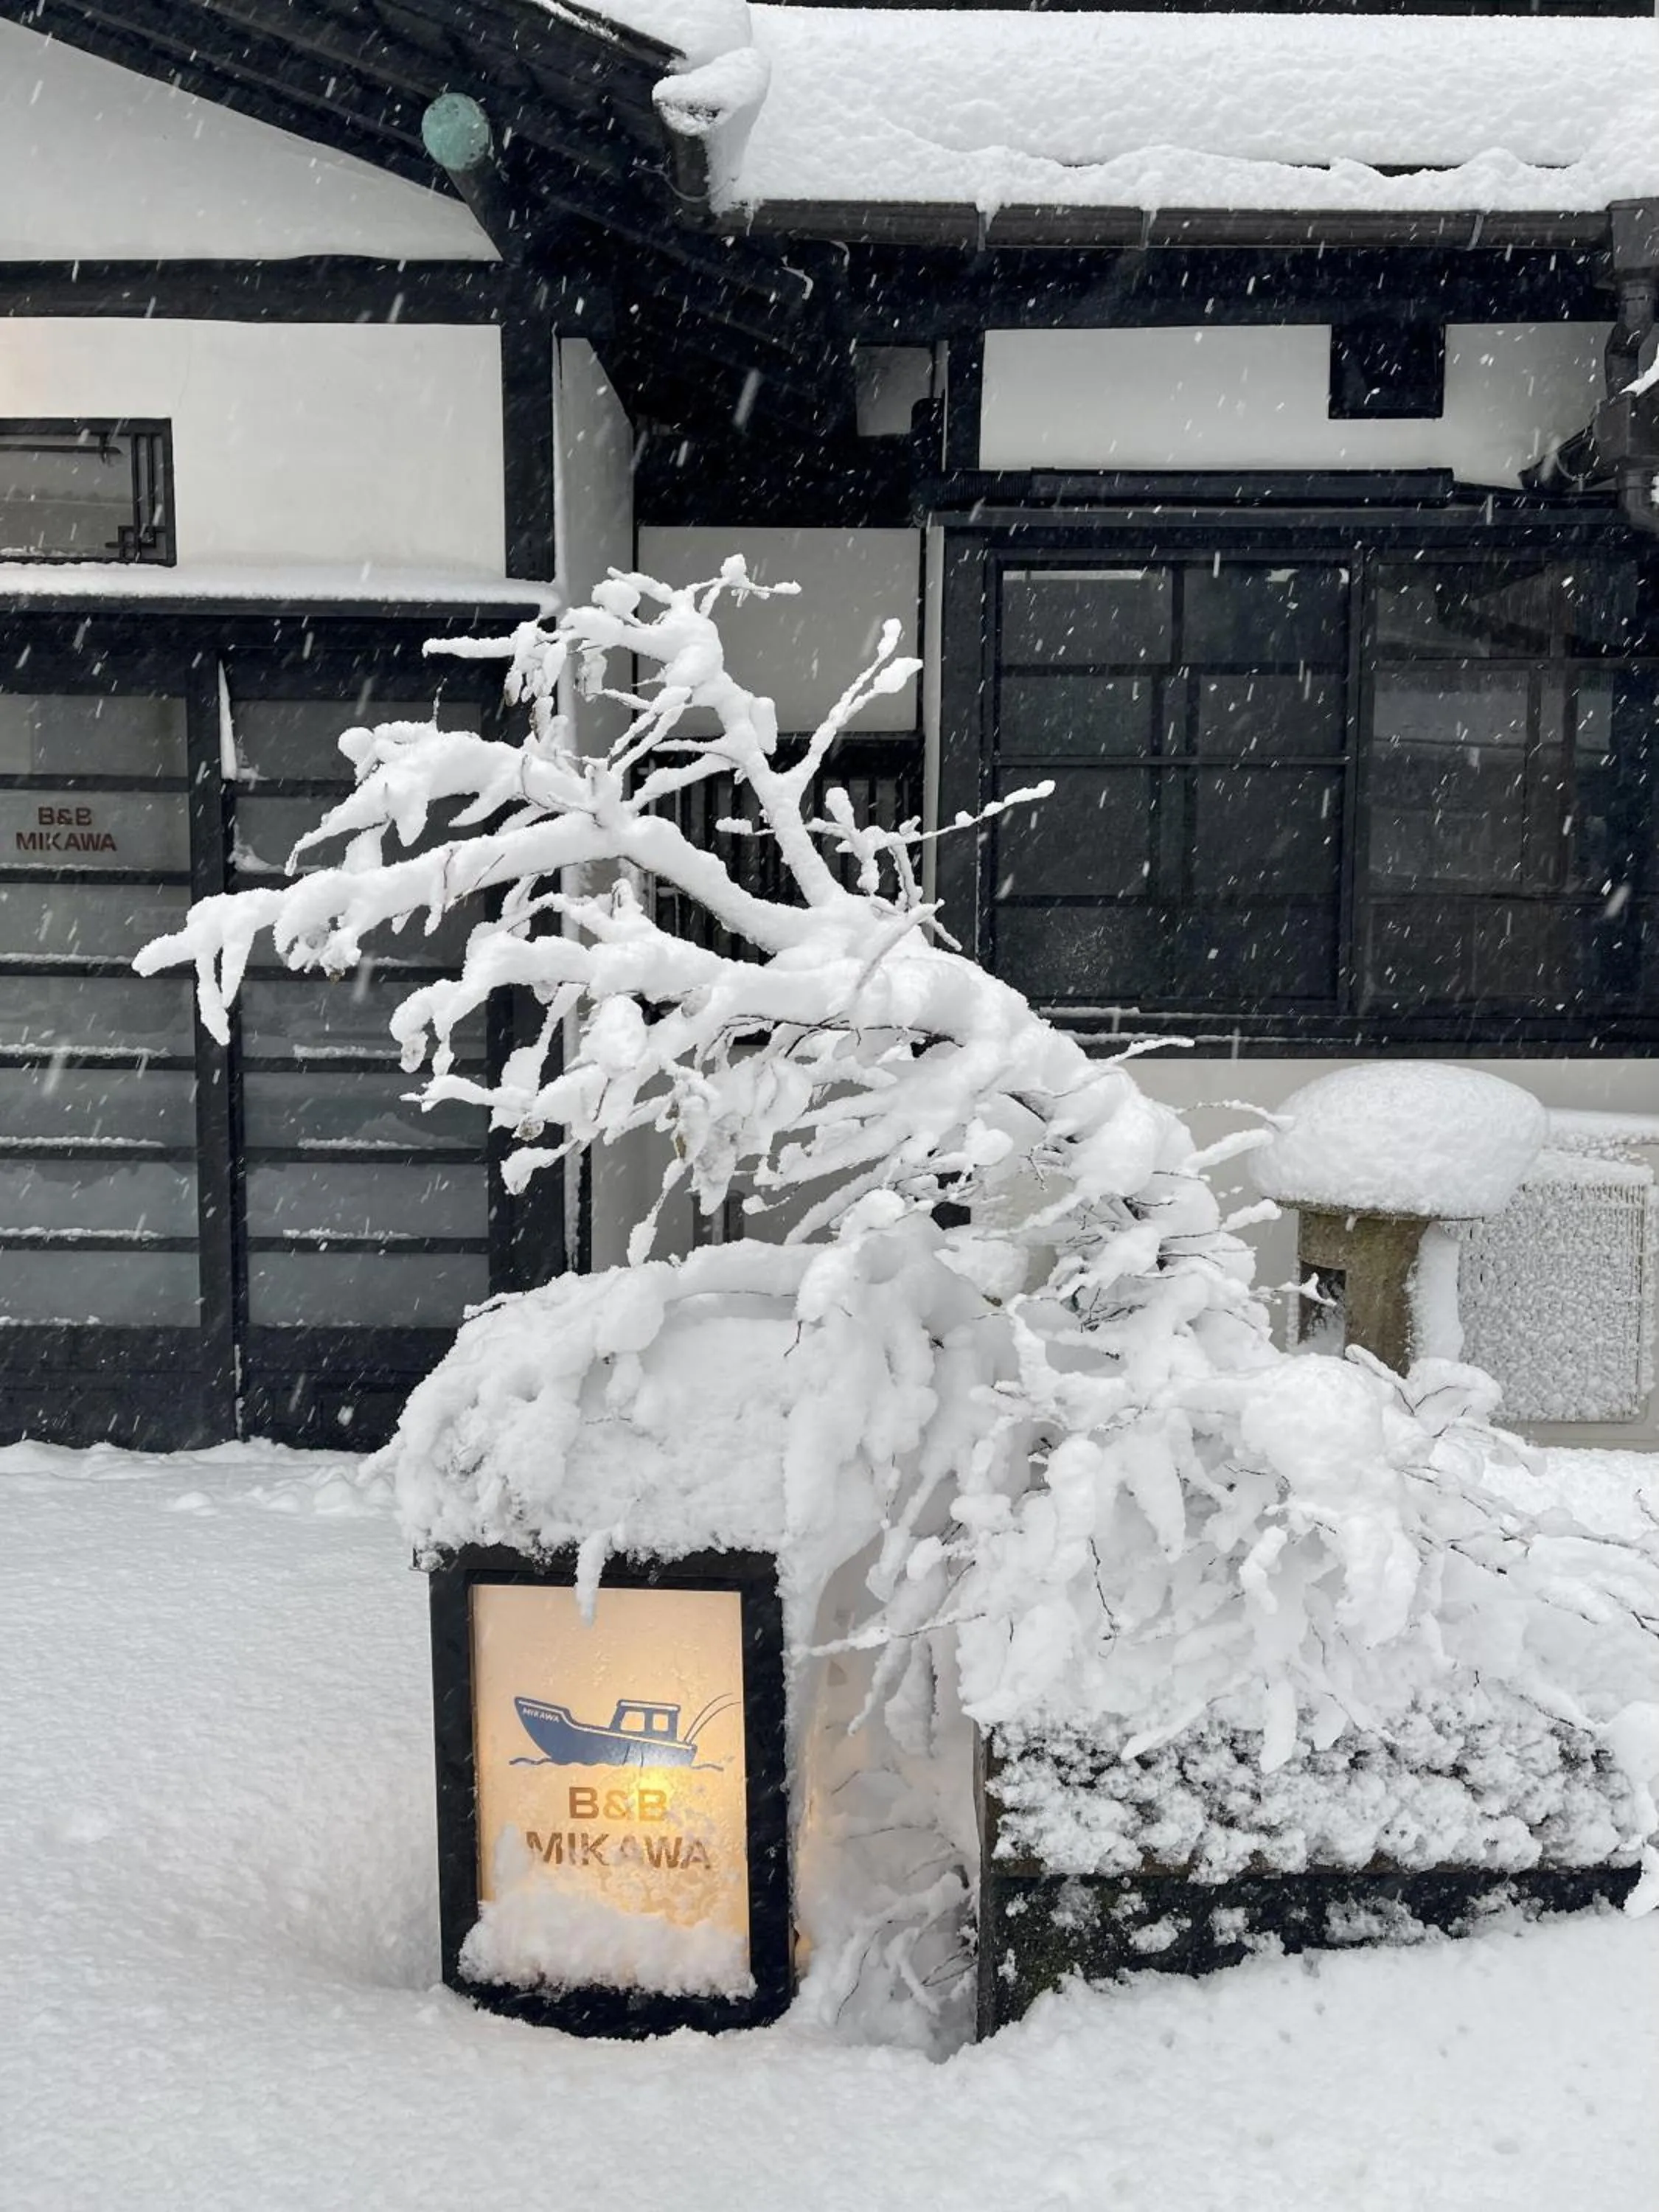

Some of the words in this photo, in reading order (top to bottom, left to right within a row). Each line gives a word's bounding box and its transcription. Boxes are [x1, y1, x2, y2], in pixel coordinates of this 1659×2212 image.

[38, 807, 91, 825] B&B
[15, 832, 117, 852] MIKAWA
[522, 1707, 559, 1722] MIKAWA
[568, 1787, 667, 1821] B&B
